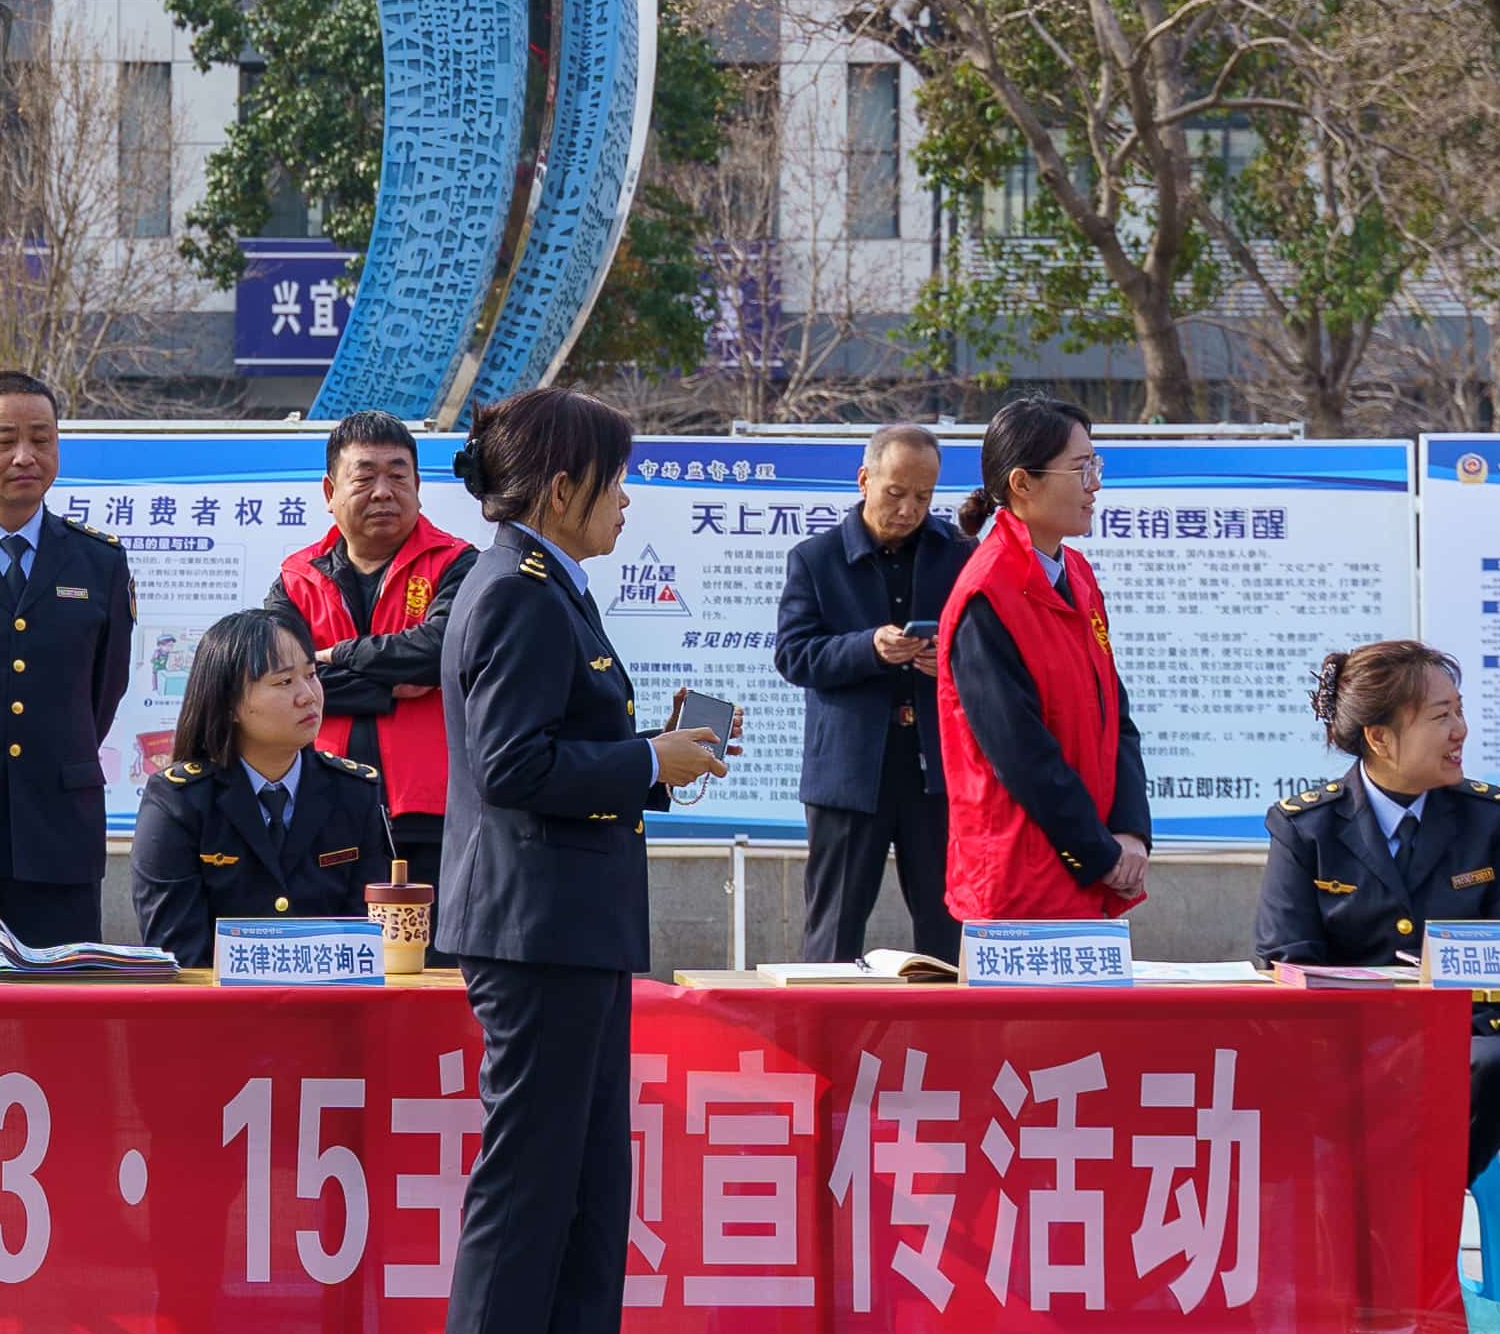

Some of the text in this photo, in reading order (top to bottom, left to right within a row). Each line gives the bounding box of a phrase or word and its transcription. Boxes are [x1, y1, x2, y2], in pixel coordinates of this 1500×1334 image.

[271, 279, 352, 338] 兴宜
[638, 459, 777, 481] 市场监督管理
[62, 495, 308, 527] 与消费者权益
[691, 501, 852, 536] 天上不会
[1083, 506, 1289, 541] 传销要清醒
[621, 564, 676, 583] 什么是
[229, 942, 376, 975] 法律法规咨询台
[976, 945, 1124, 976] 投诉举报受理
